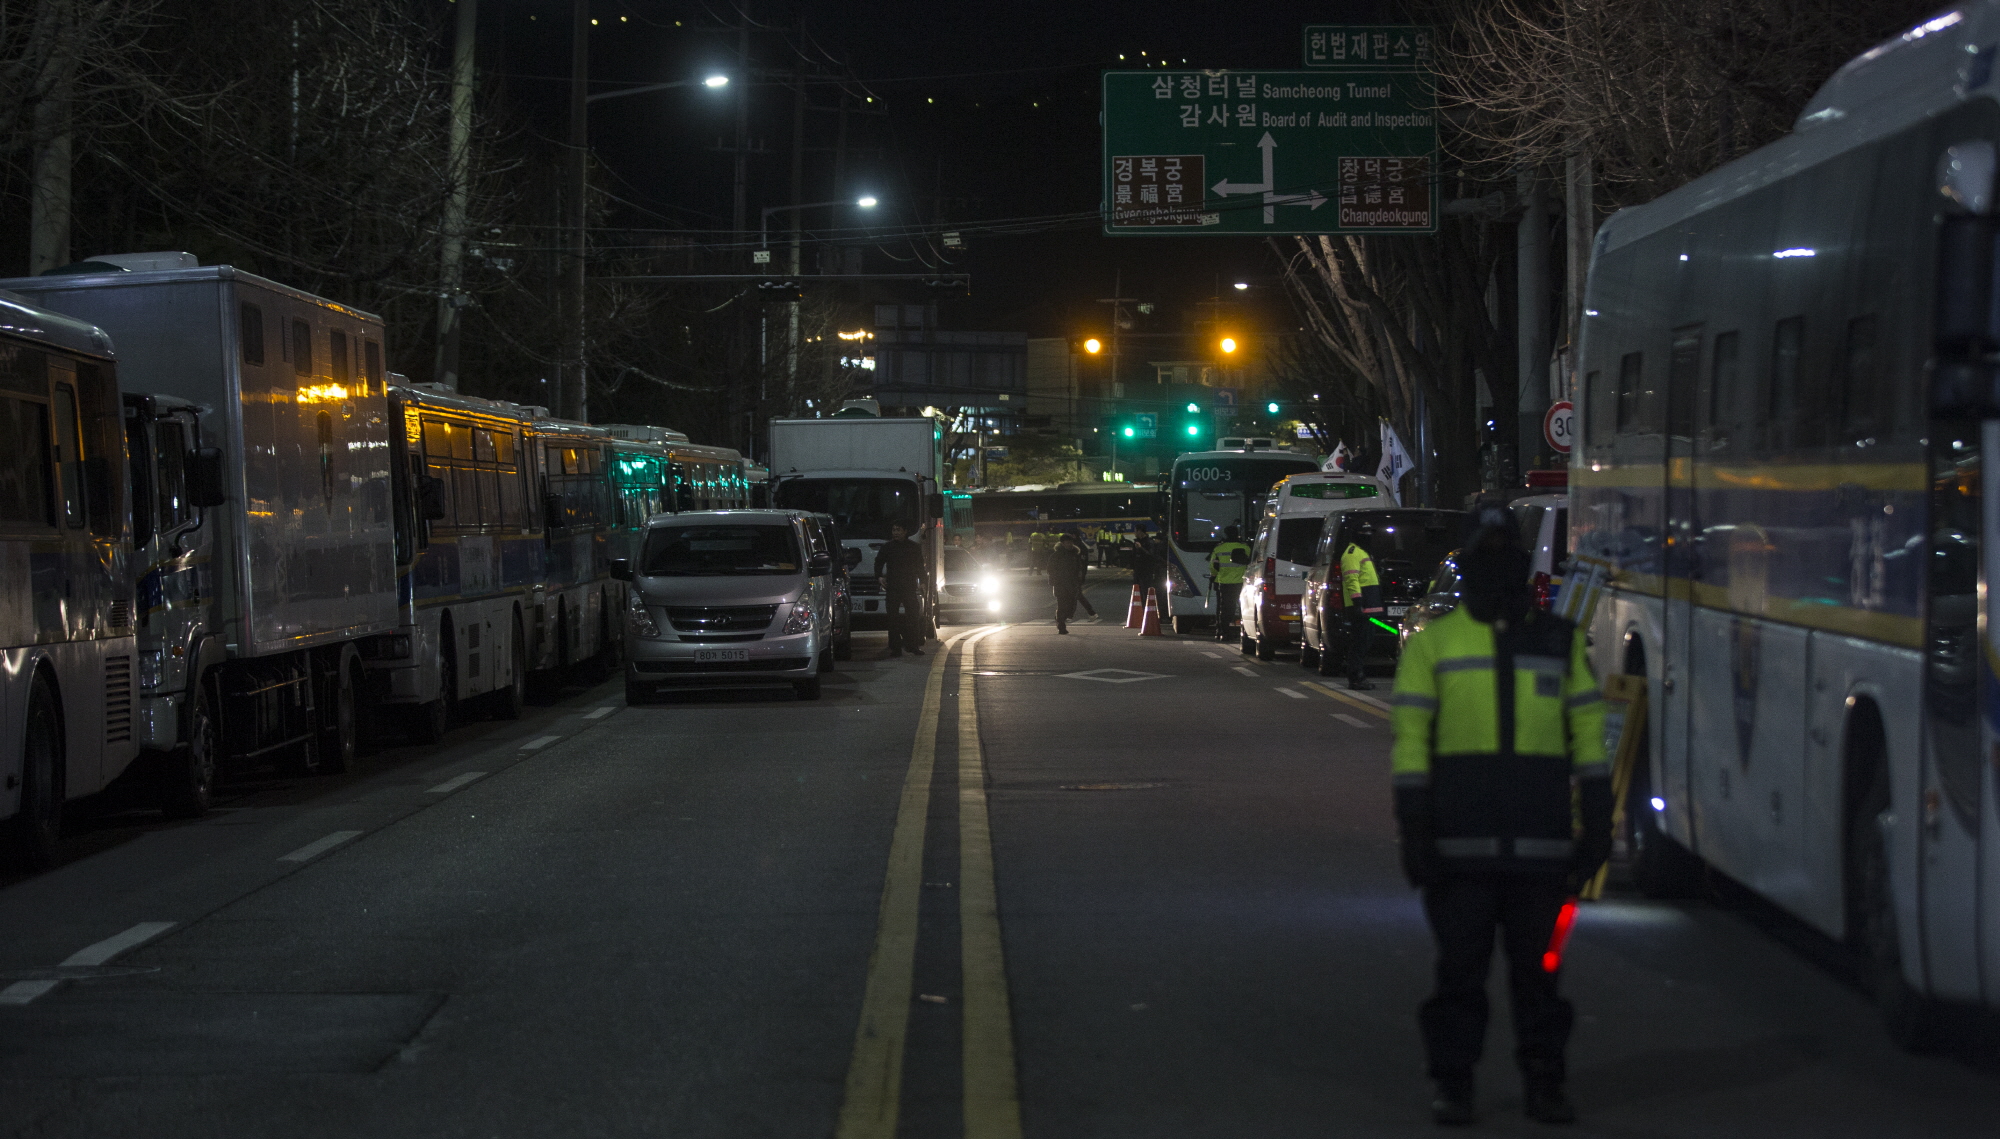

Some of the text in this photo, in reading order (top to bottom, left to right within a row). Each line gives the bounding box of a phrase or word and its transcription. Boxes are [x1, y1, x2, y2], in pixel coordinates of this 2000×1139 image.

[1151, 75, 1256, 99] 삼청터널
[1262, 82, 1391, 101] Samcheong Tunnel
[1179, 103, 1257, 127] 감사원
[1262, 112, 1432, 130] Board of Audit and Inspection
[1115, 158, 1183, 182] 경복궁
[1341, 158, 1404, 184] 창덕궁
[1115, 183, 1183, 204] 景福宮
[1341, 207, 1428, 226] Changdeokgung
[1555, 416, 1574, 437] 30
[1185, 466, 1232, 481] 1600-3
[721, 650, 744, 660] 5015
